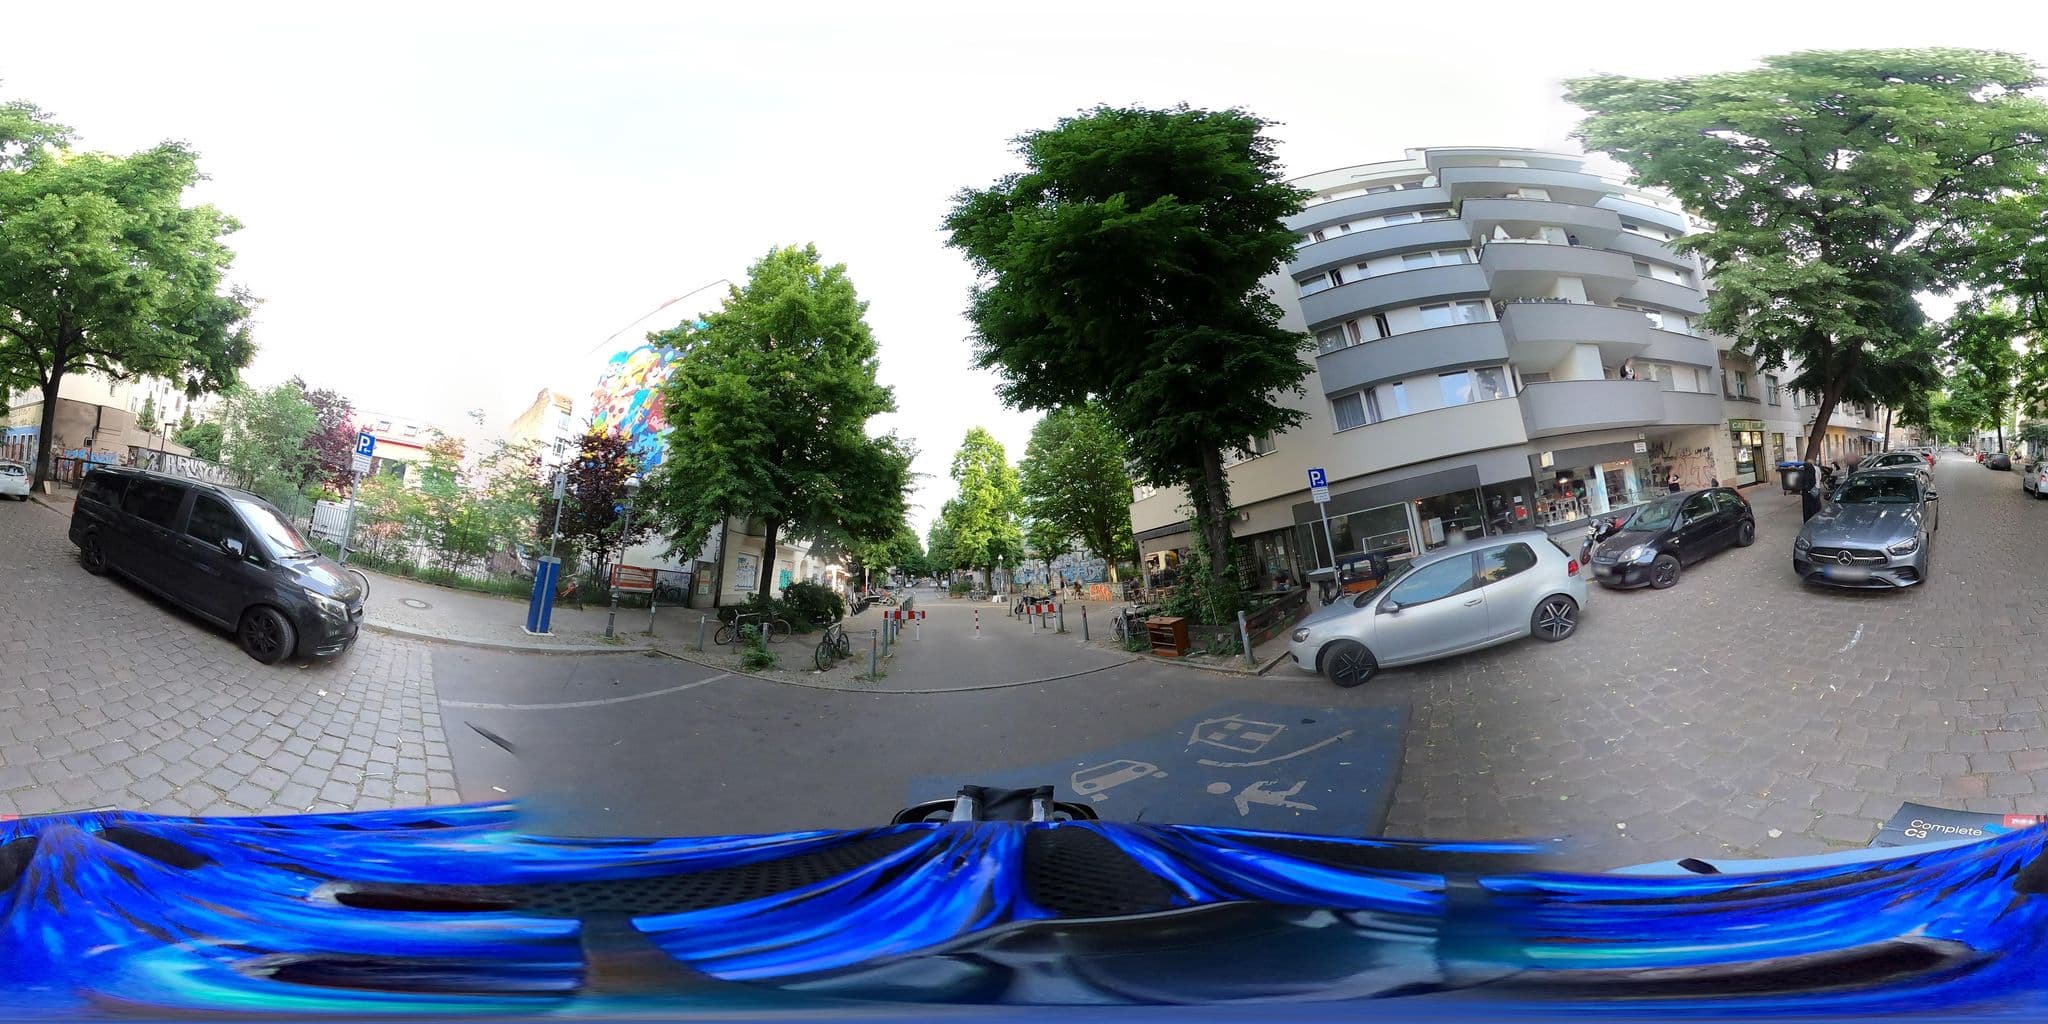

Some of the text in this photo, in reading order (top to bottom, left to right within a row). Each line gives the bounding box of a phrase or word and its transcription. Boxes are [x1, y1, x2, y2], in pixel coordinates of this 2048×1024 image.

[358, 435, 371, 452] P
[1310, 470, 1321, 486] P
[1904, 829, 1928, 839] C3
[1911, 819, 1983, 837] Complete
